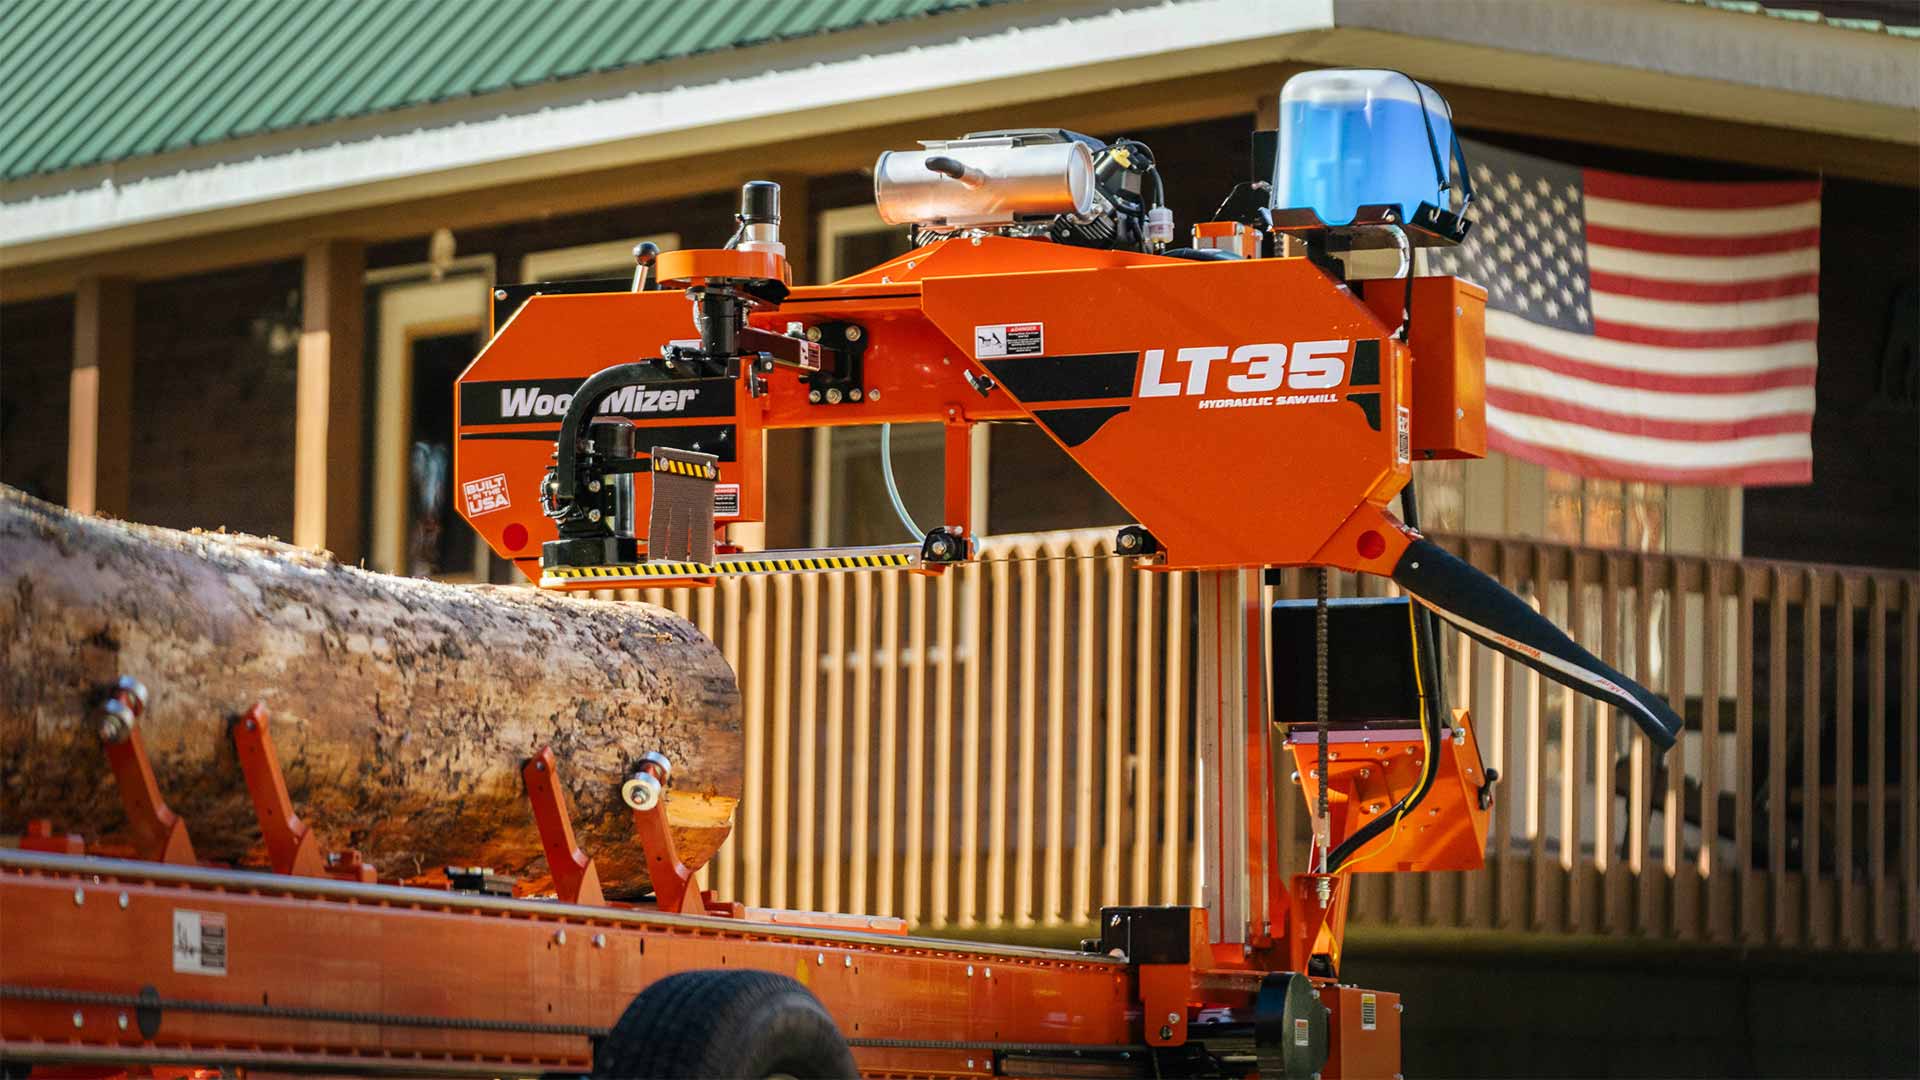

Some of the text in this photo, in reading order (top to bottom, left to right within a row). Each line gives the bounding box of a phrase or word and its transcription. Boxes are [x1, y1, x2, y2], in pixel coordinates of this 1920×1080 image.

[1138, 339, 1350, 398] LT35
[1198, 393, 1339, 410] HYDRAULIC SAWMILL
[466, 476, 504, 495] BUILT
[472, 488, 501, 501] IN THE
[469, 494, 509, 513] USA
